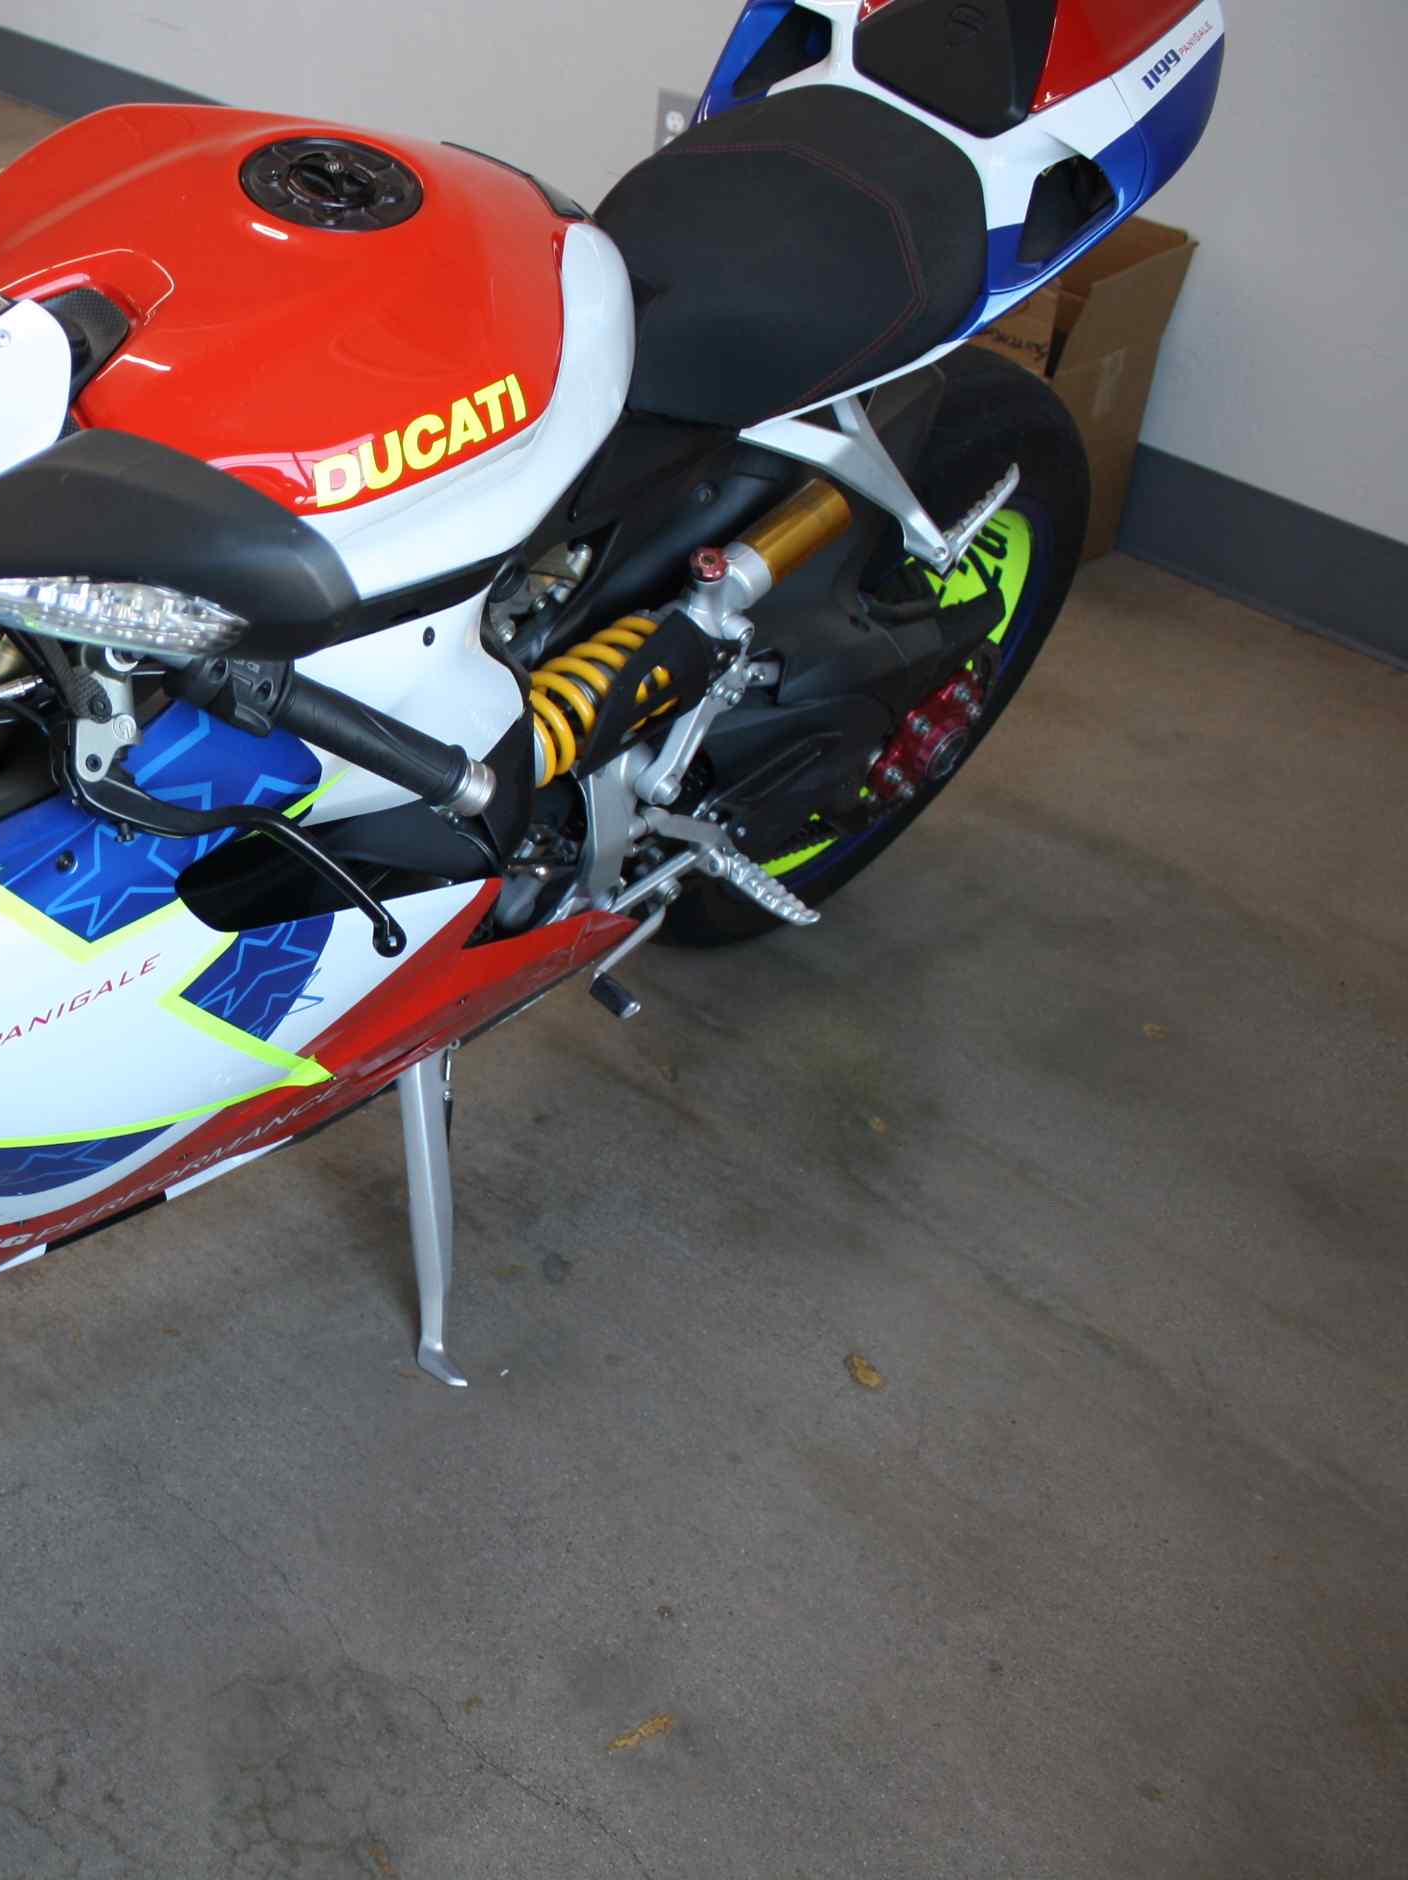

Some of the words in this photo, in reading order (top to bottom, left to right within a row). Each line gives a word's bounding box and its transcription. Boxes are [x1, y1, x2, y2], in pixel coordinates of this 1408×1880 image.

[1141, 48, 1181, 91] 1199
[1178, 19, 1214, 56] PANIGALE
[311, 373, 528, 508] DUCATI
